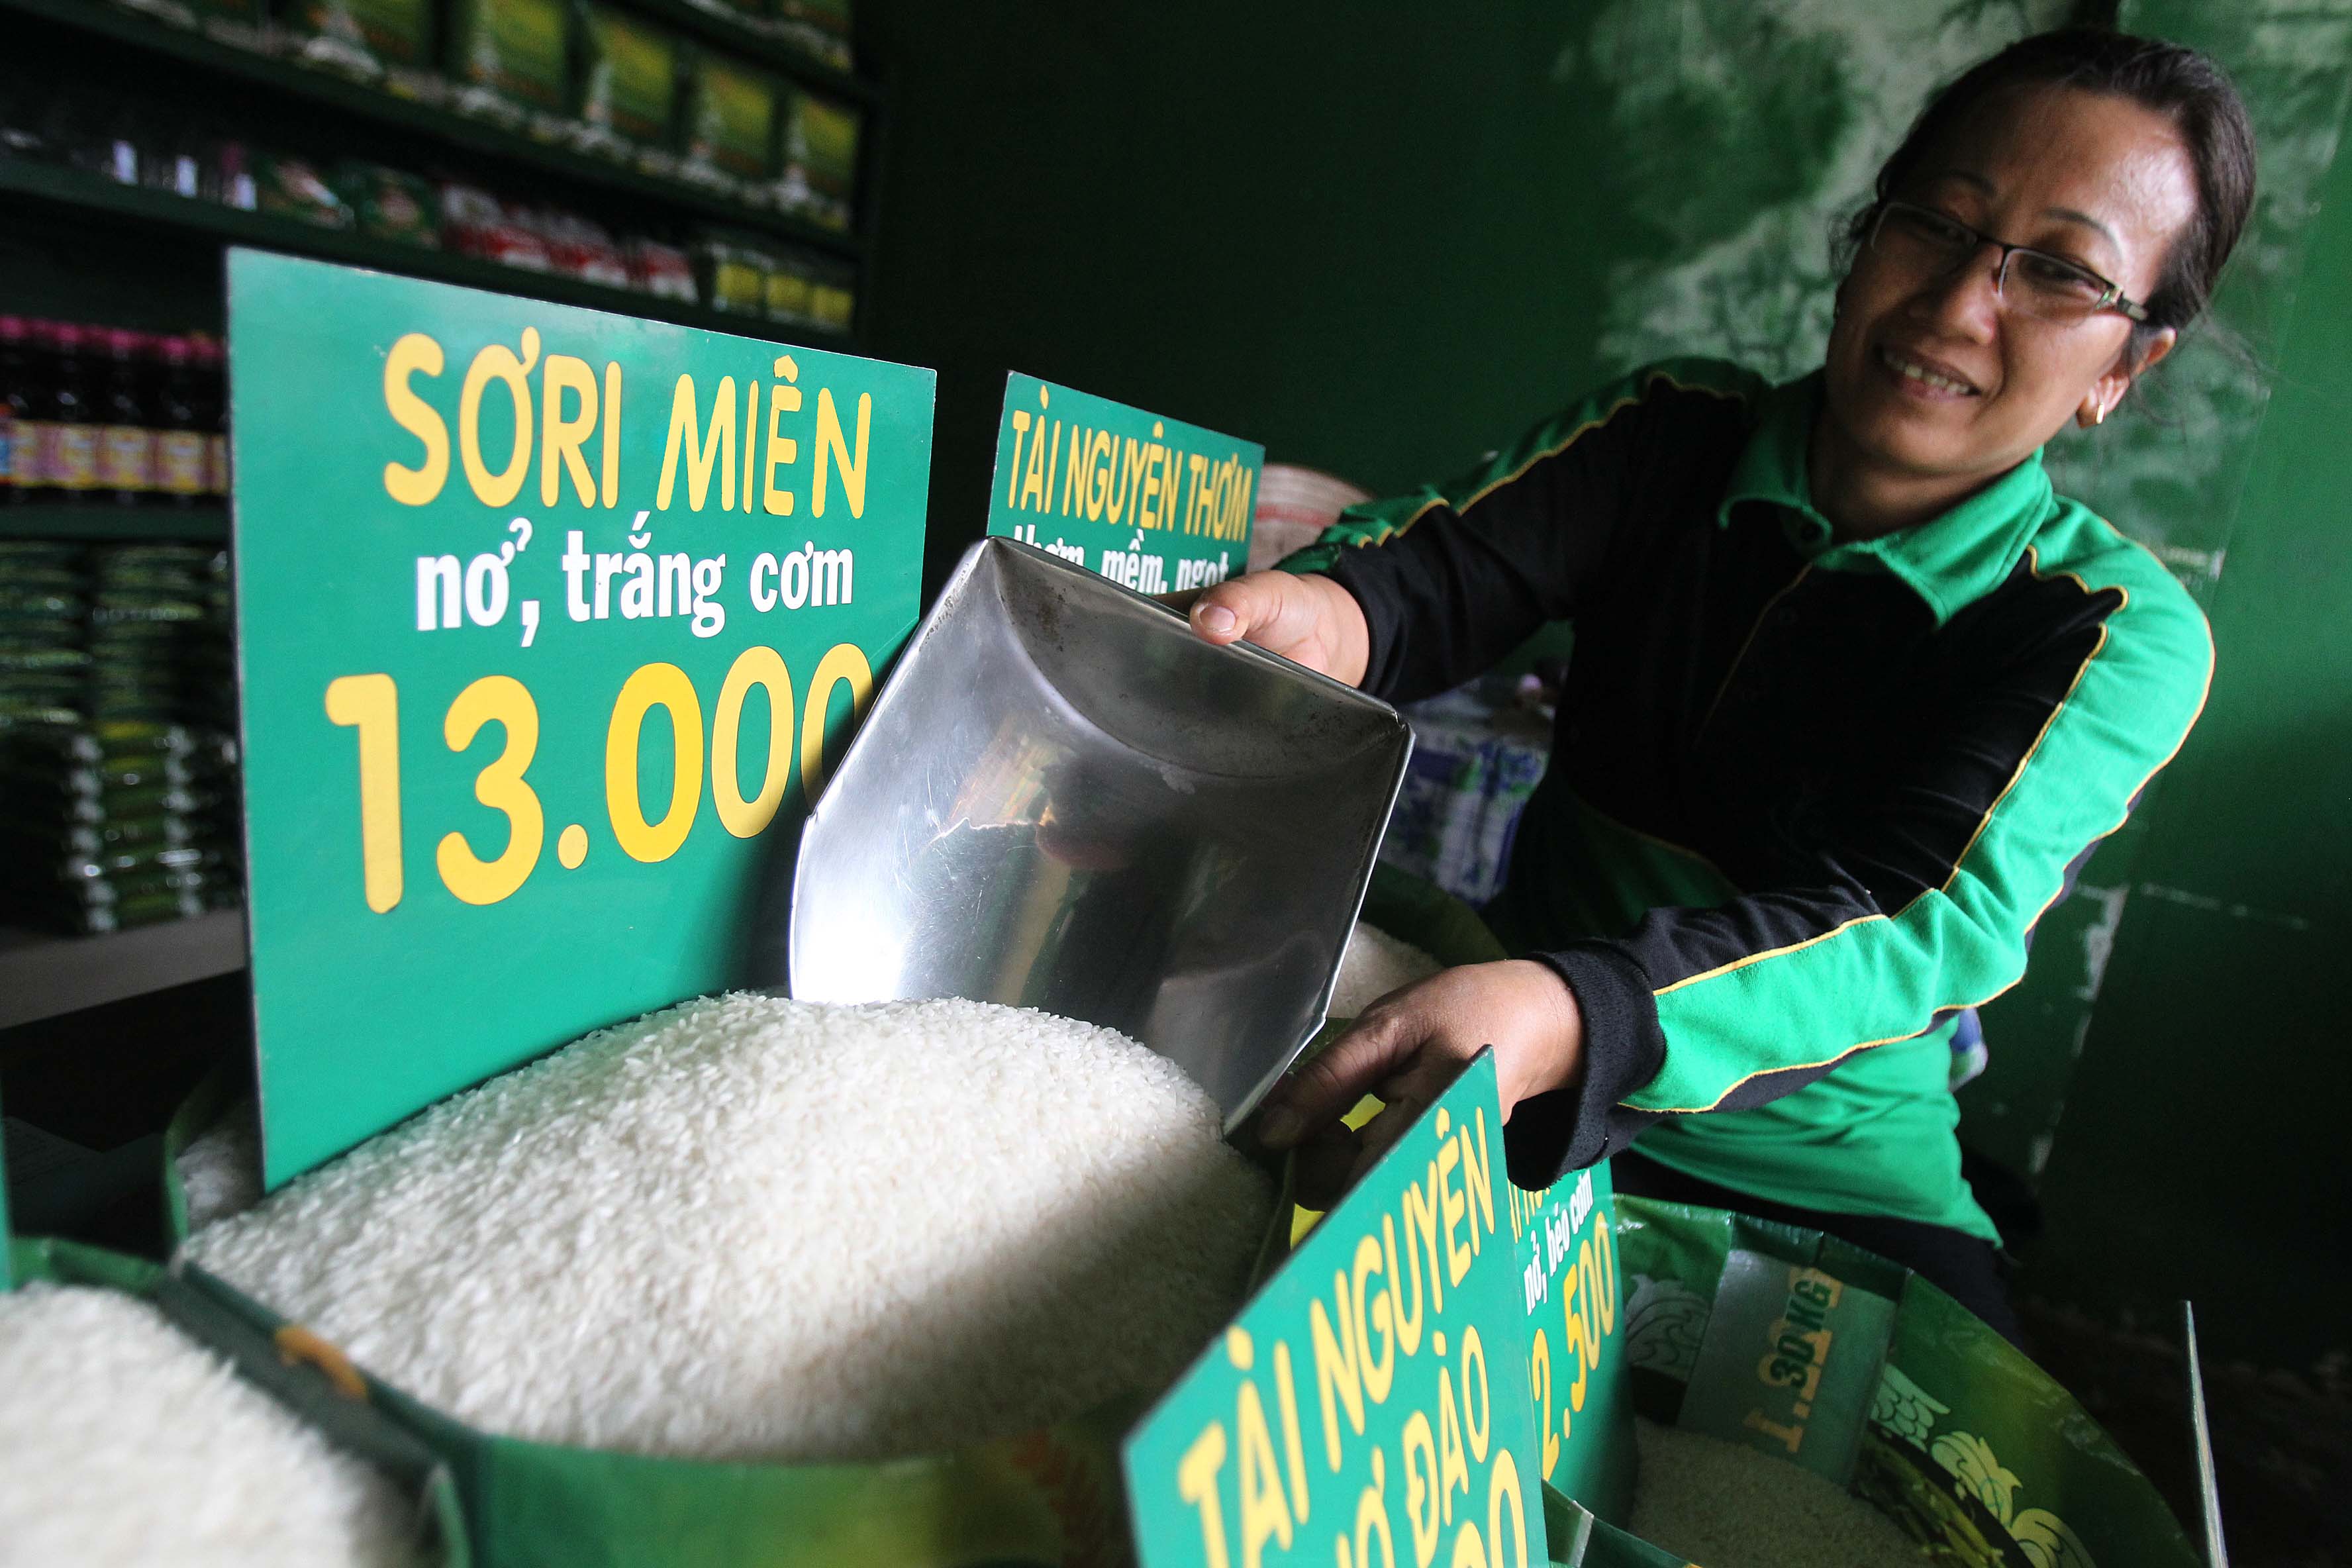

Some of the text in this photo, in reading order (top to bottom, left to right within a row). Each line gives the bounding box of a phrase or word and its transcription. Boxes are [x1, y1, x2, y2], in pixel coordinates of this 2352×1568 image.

[384, 326, 873, 518] SƠRI MIÊN
[1008, 385, 1253, 542] TÀI NGUYÊN THƠM
[416, 511, 853, 648] nở, trắng cơm
[324, 642, 873, 914] 13.000
[1177, 1324, 1310, 1568] TÀI
[1310, 1107, 1495, 1473] NGUYÊN
[1523, 1230, 1547, 1316] nở,
[1545, 1202, 1571, 1277] béo
[1402, 1324, 1490, 1568] ĐÀO
